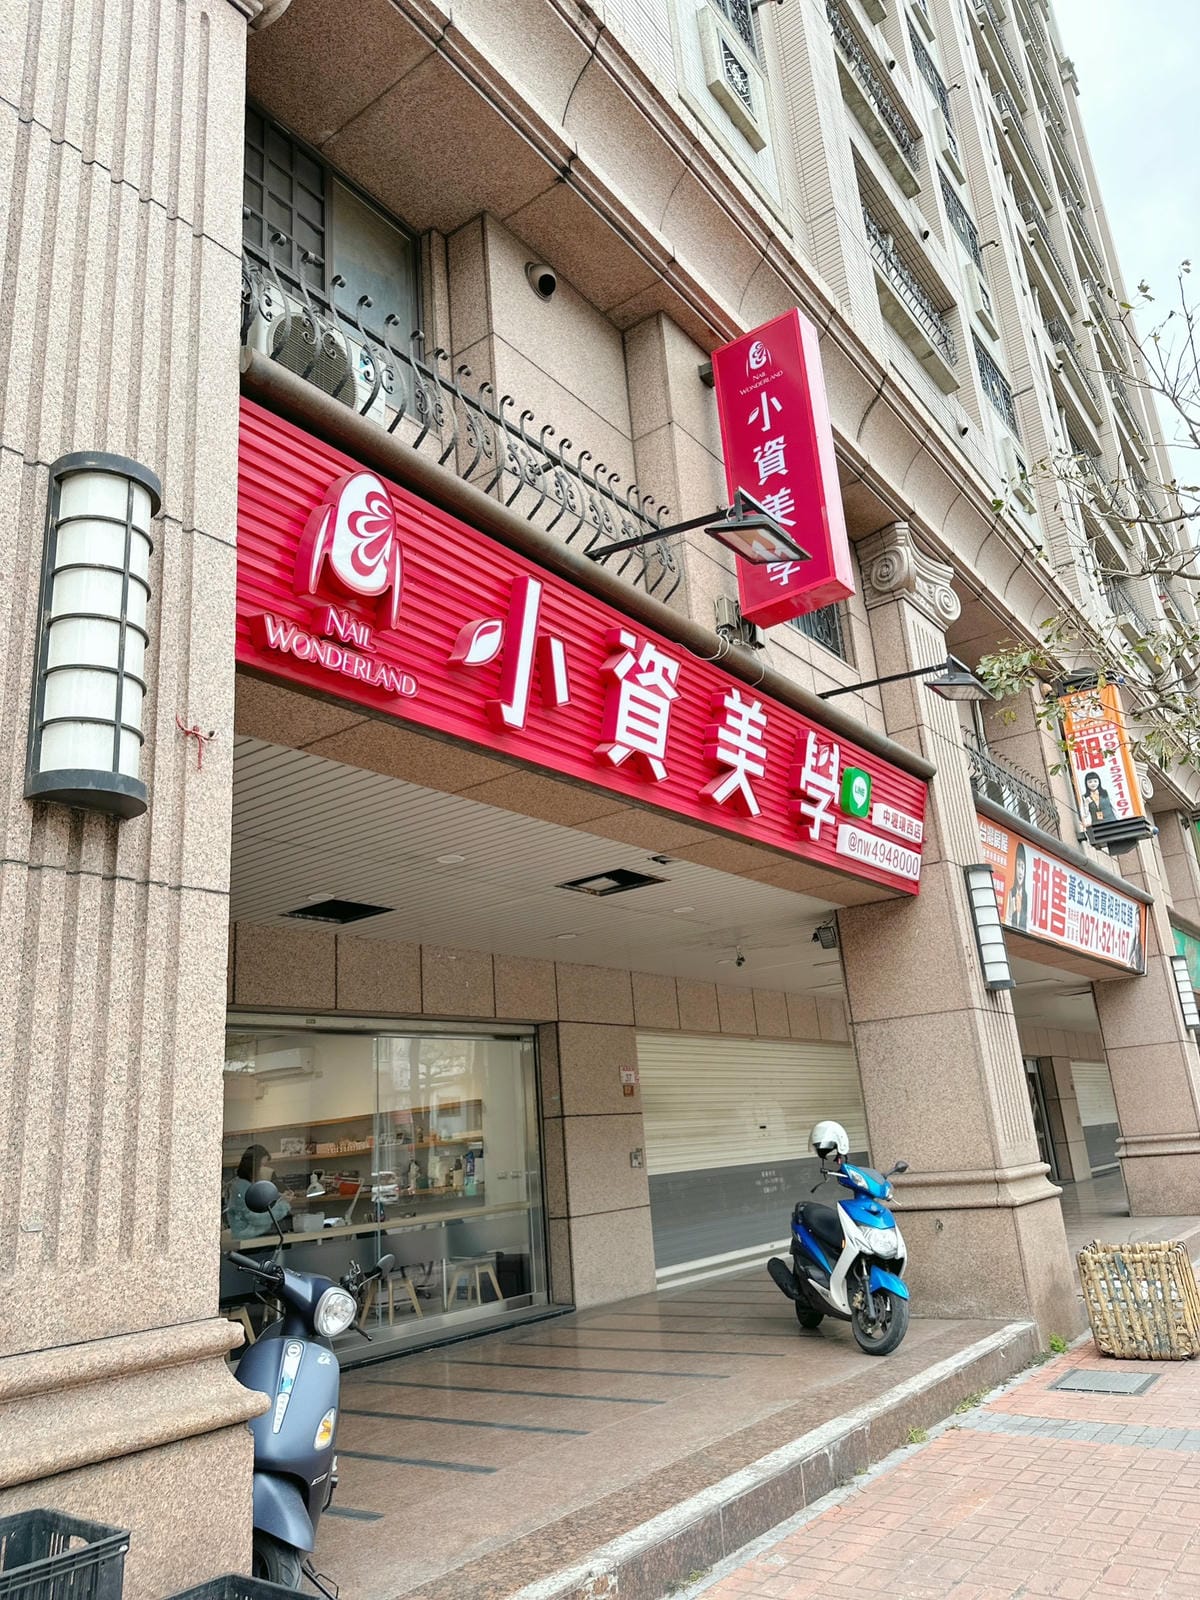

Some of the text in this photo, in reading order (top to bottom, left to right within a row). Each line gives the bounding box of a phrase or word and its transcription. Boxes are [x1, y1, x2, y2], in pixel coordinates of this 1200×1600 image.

[739, 370, 784, 396] WONDERLAND
[264, 613, 419, 699] WONDERLAND
[326, 606, 376, 651] NAIL
[455, 575, 842, 843] 小資美學
[1102, 732, 1130, 817] 091521167
[848, 831, 919, 876] @nw4948000
[1031, 856, 1068, 938] 租售
[1079, 911, 1130, 961] 0971-521-167
